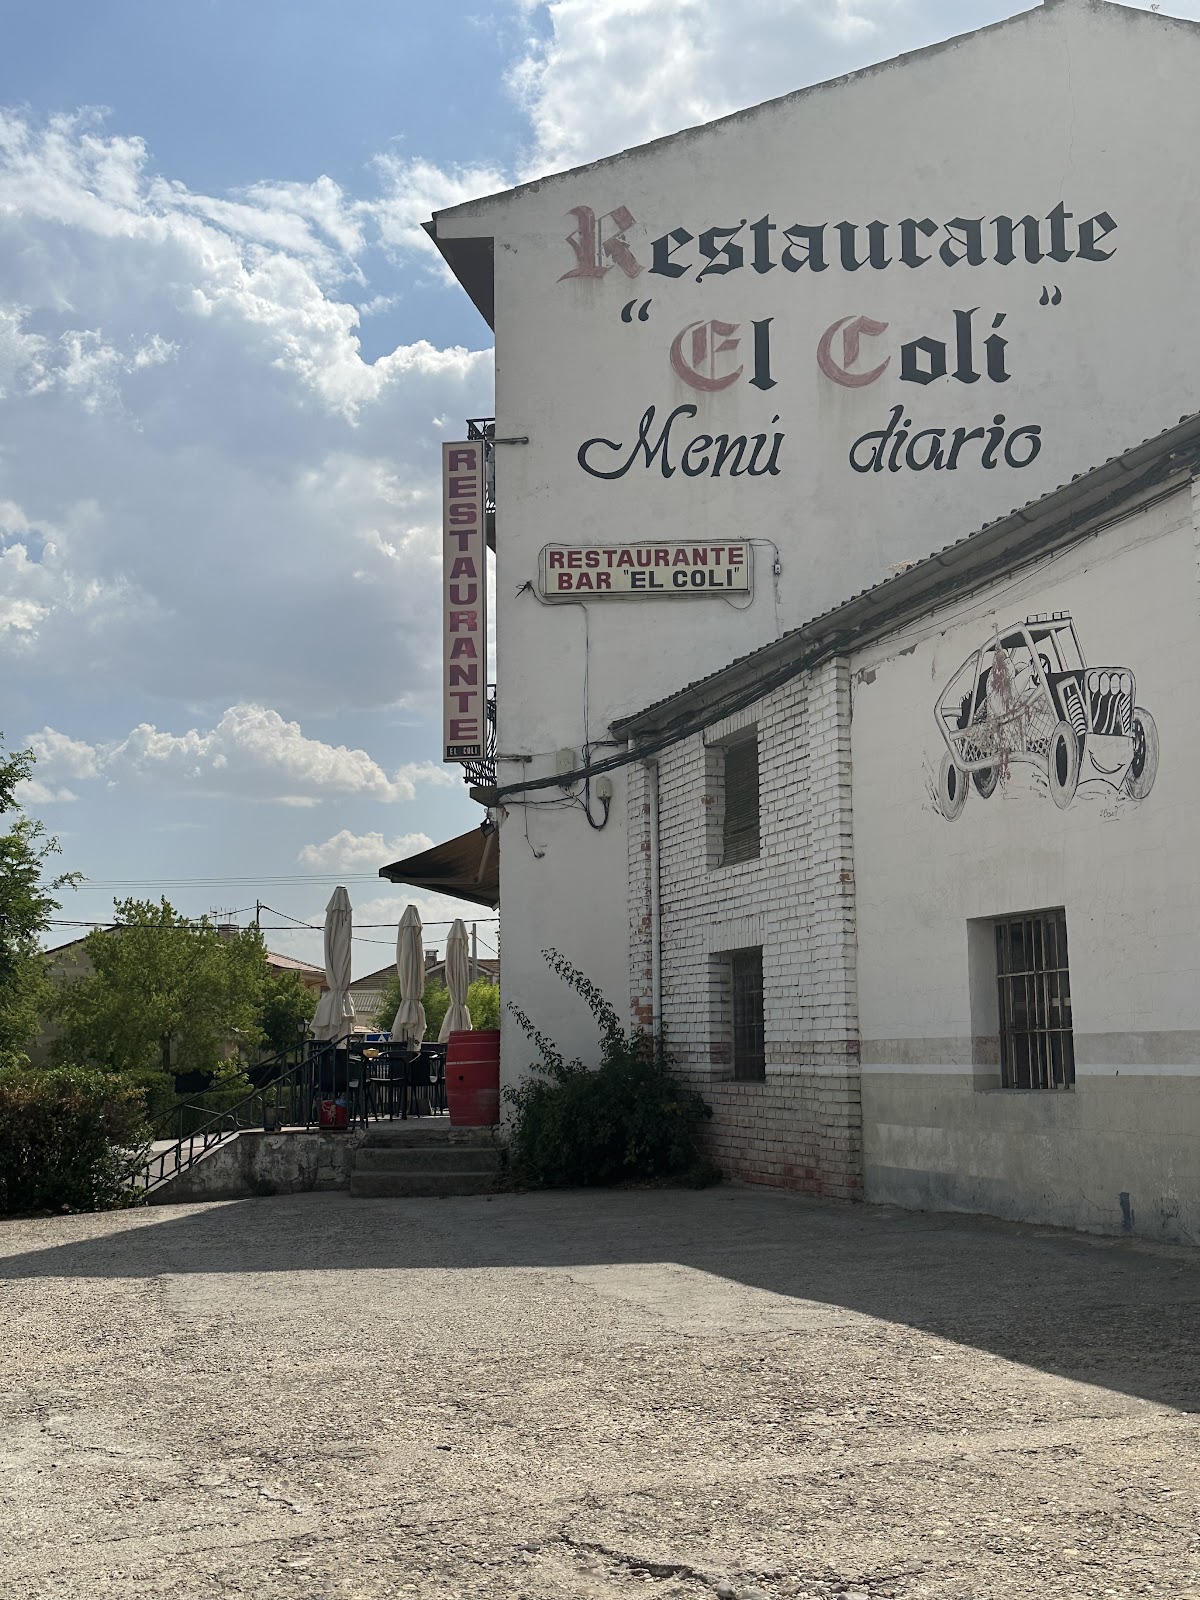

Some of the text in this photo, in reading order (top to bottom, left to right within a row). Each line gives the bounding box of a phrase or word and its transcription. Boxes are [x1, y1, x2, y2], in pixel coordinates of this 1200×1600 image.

[556, 200, 1119, 284] Restaurante
[576, 404, 1043, 480] Menú diario
[549, 546, 744, 569] RESTAURANTE
[557, 566, 740, 591] BAR "EL COLI"
[449, 448, 478, 740] RESTAURANTE
[449, 746, 478, 756] EL COLI
